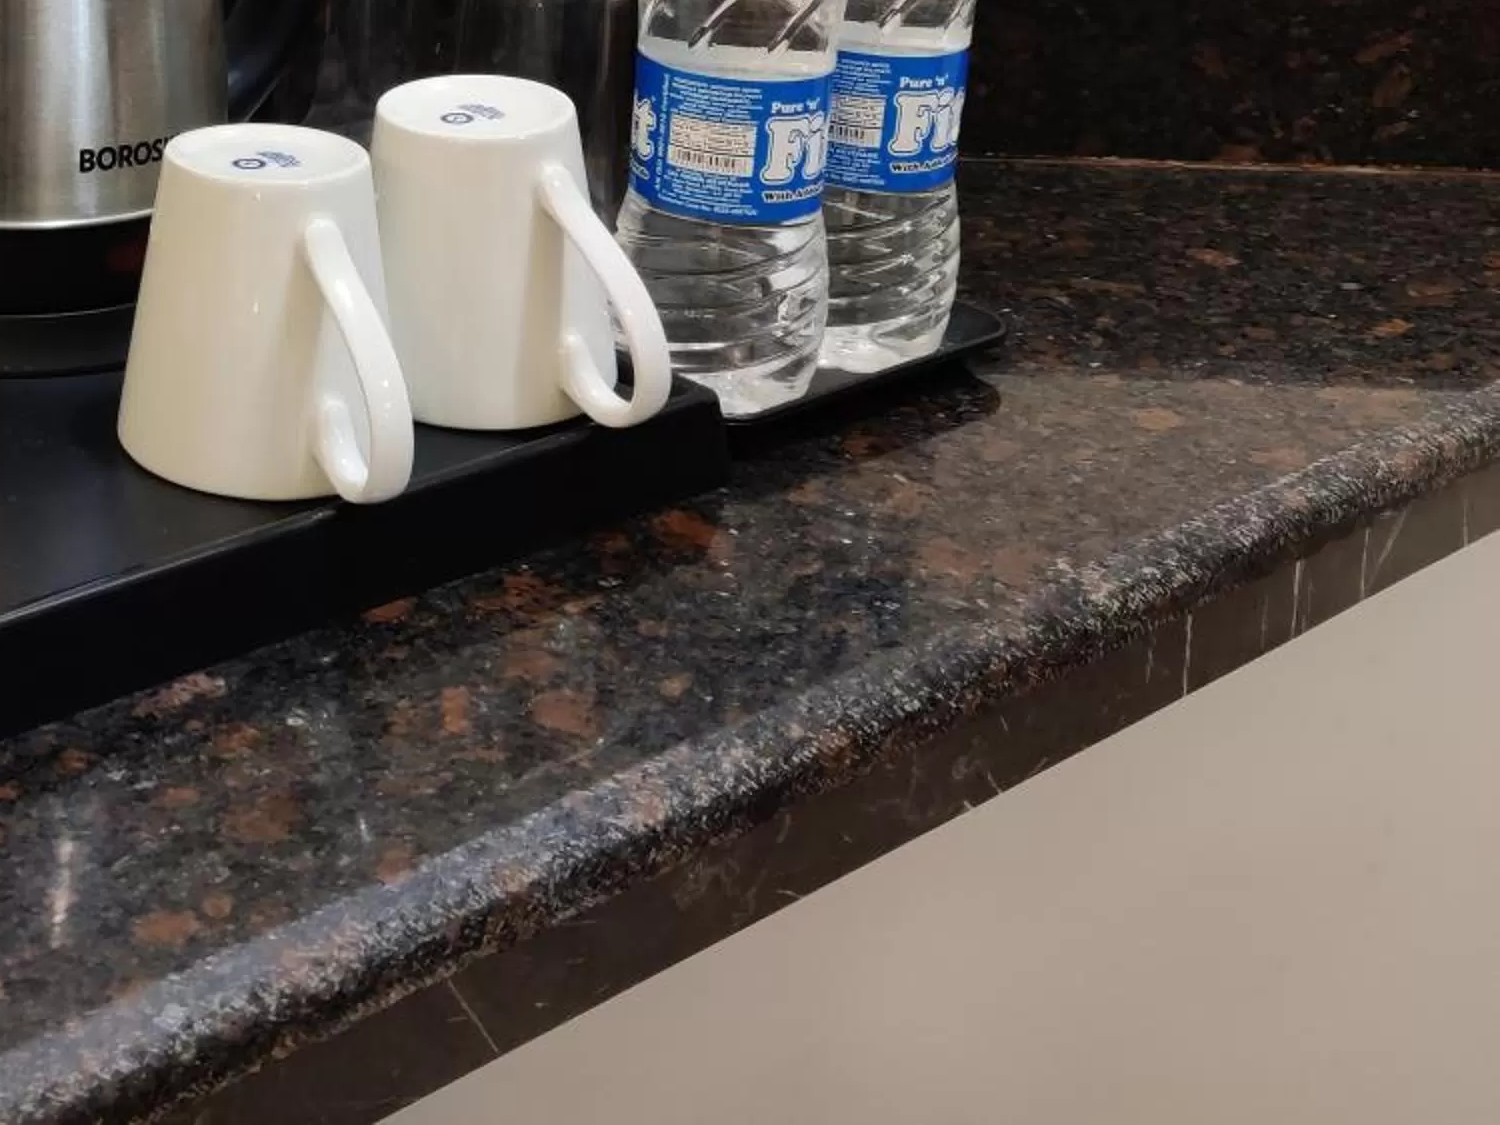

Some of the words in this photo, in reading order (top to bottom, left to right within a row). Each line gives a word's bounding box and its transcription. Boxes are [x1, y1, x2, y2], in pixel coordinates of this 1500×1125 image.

[899, 76, 933, 89] Pure
[771, 101, 805, 114] Pure
[79, 136, 170, 173] BOROS
[760, 111, 827, 185] Fi
